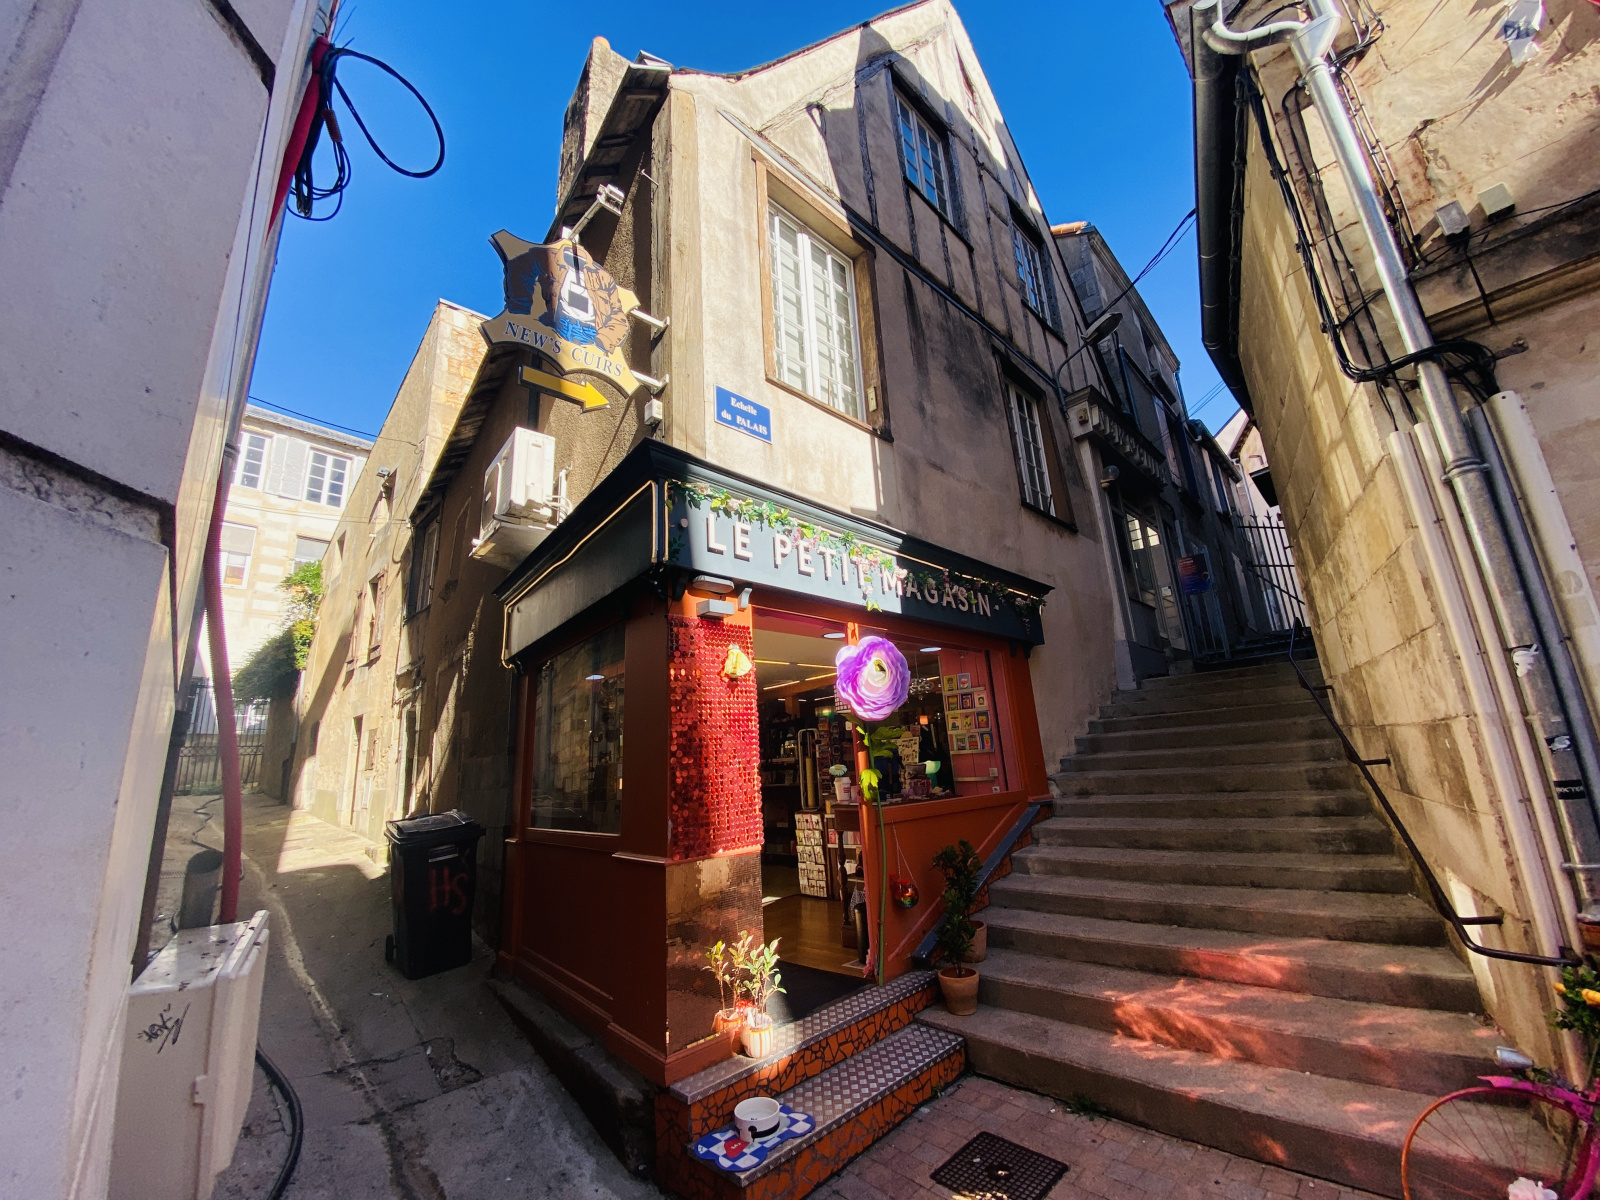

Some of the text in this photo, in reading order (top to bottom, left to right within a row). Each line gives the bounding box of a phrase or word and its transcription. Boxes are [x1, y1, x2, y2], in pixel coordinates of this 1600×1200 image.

[505, 321, 623, 377] NEW'S CUIRS
[721, 409, 768, 436] du PALAIS
[730, 396, 758, 416] Echelle
[708, 512, 753, 559] LE
